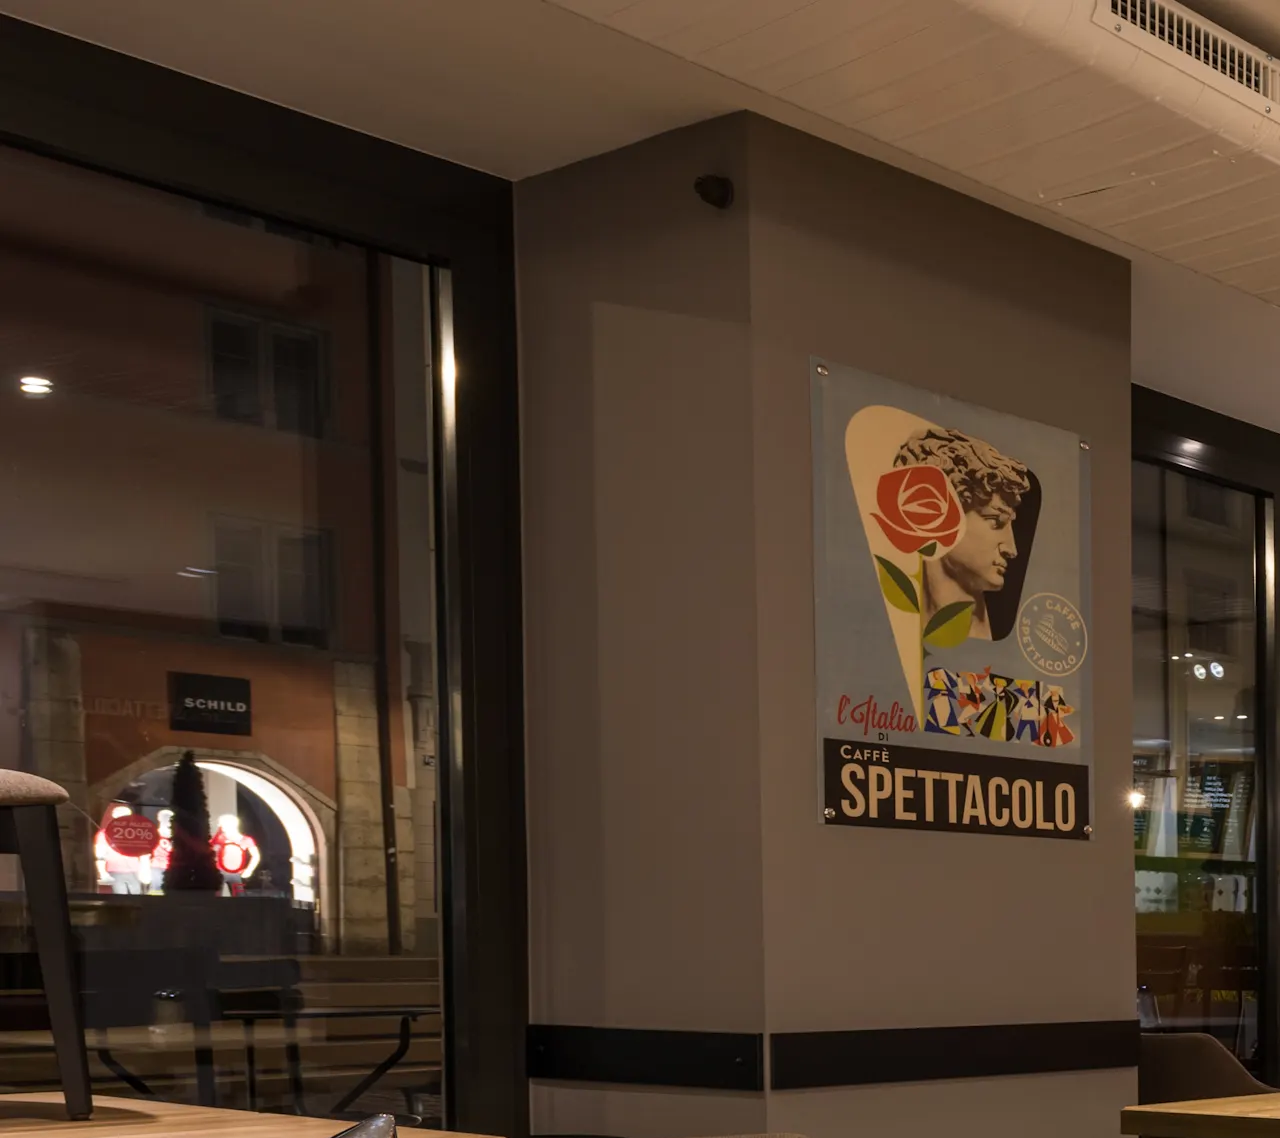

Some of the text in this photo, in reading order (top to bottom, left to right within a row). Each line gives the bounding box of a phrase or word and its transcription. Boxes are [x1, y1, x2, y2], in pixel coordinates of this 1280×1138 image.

[1045, 599, 1081, 631] CAFFÈ
[1022, 616, 1076, 671] SPETTACOLO
[184, 697, 247, 713] SCHILD
[837, 694, 917, 736] l'Italia
[878, 732, 889, 741] DI
[840, 744, 890, 763] CAFFÈ
[840, 762, 1076, 832] SPETTACOLO
[113, 827, 153, 840] 20%
